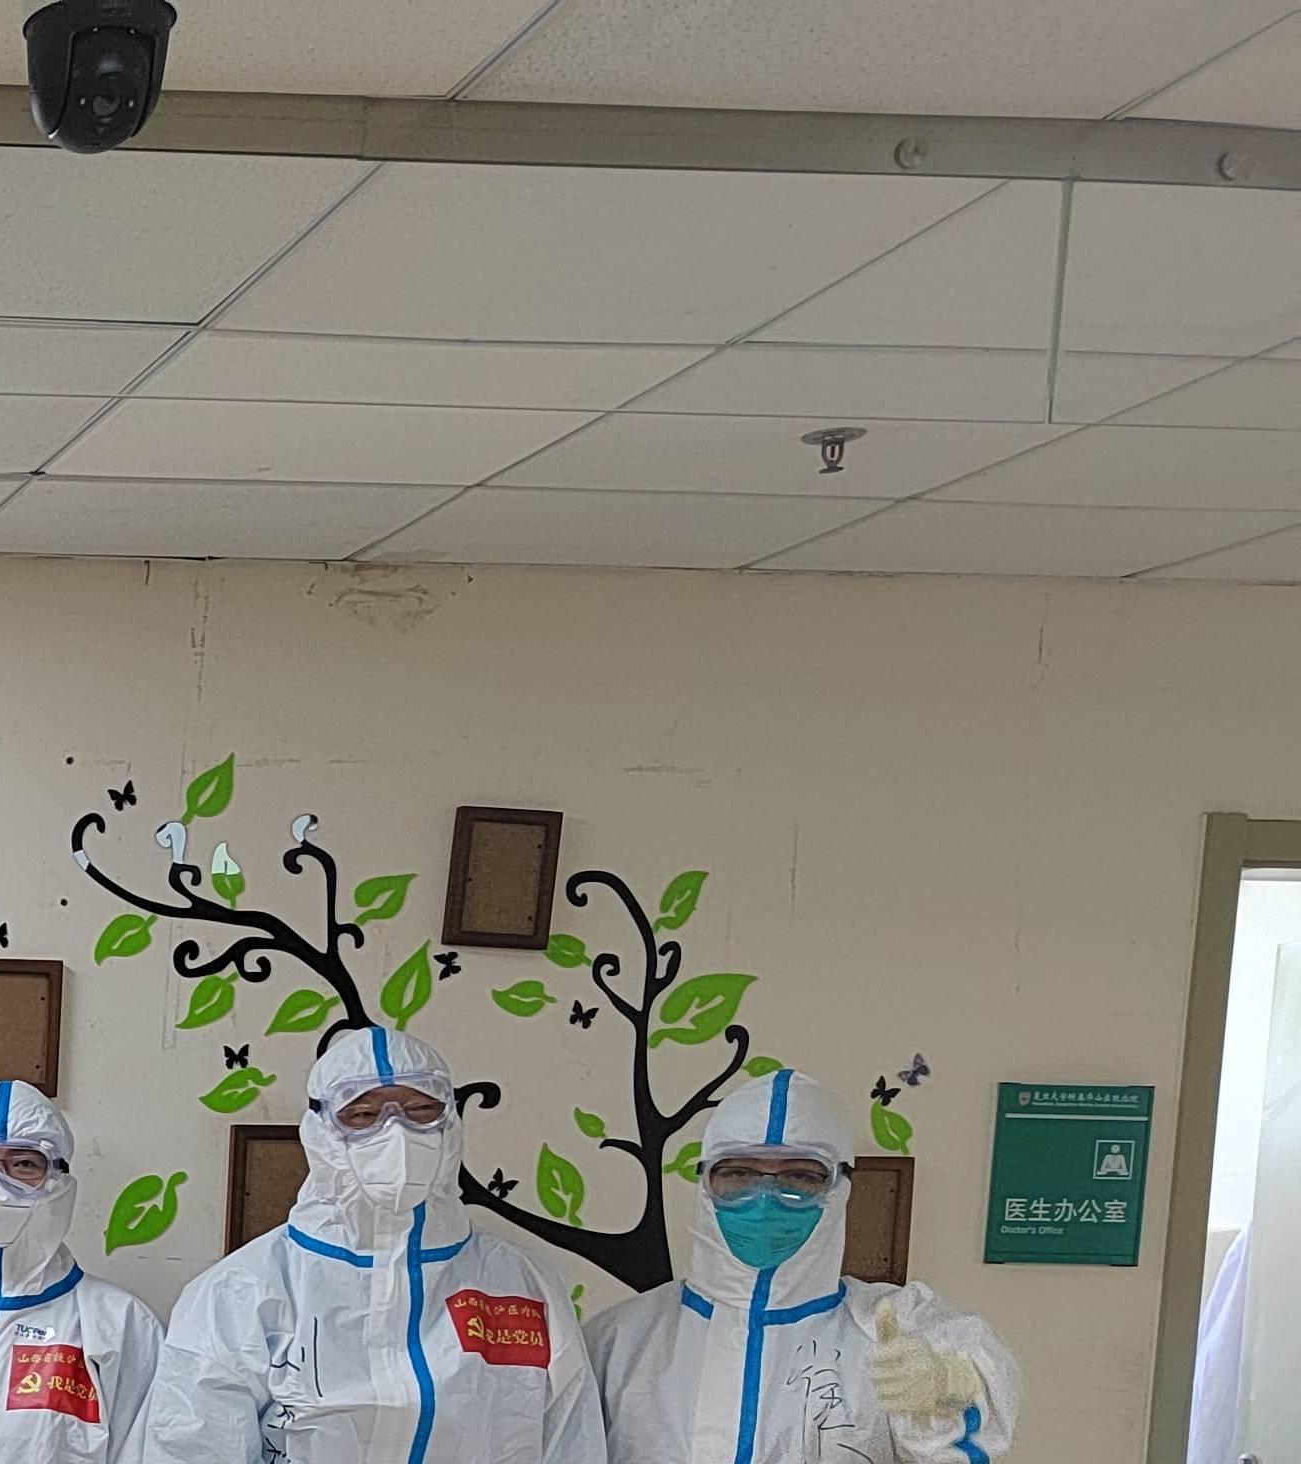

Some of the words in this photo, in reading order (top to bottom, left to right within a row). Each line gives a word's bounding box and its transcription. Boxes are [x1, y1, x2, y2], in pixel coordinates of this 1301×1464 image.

[1004, 1198, 1127, 1223] 医生办公室
[1000, 1225, 1036, 1234] Doctor's
[1038, 1226, 1064, 1235] Office
